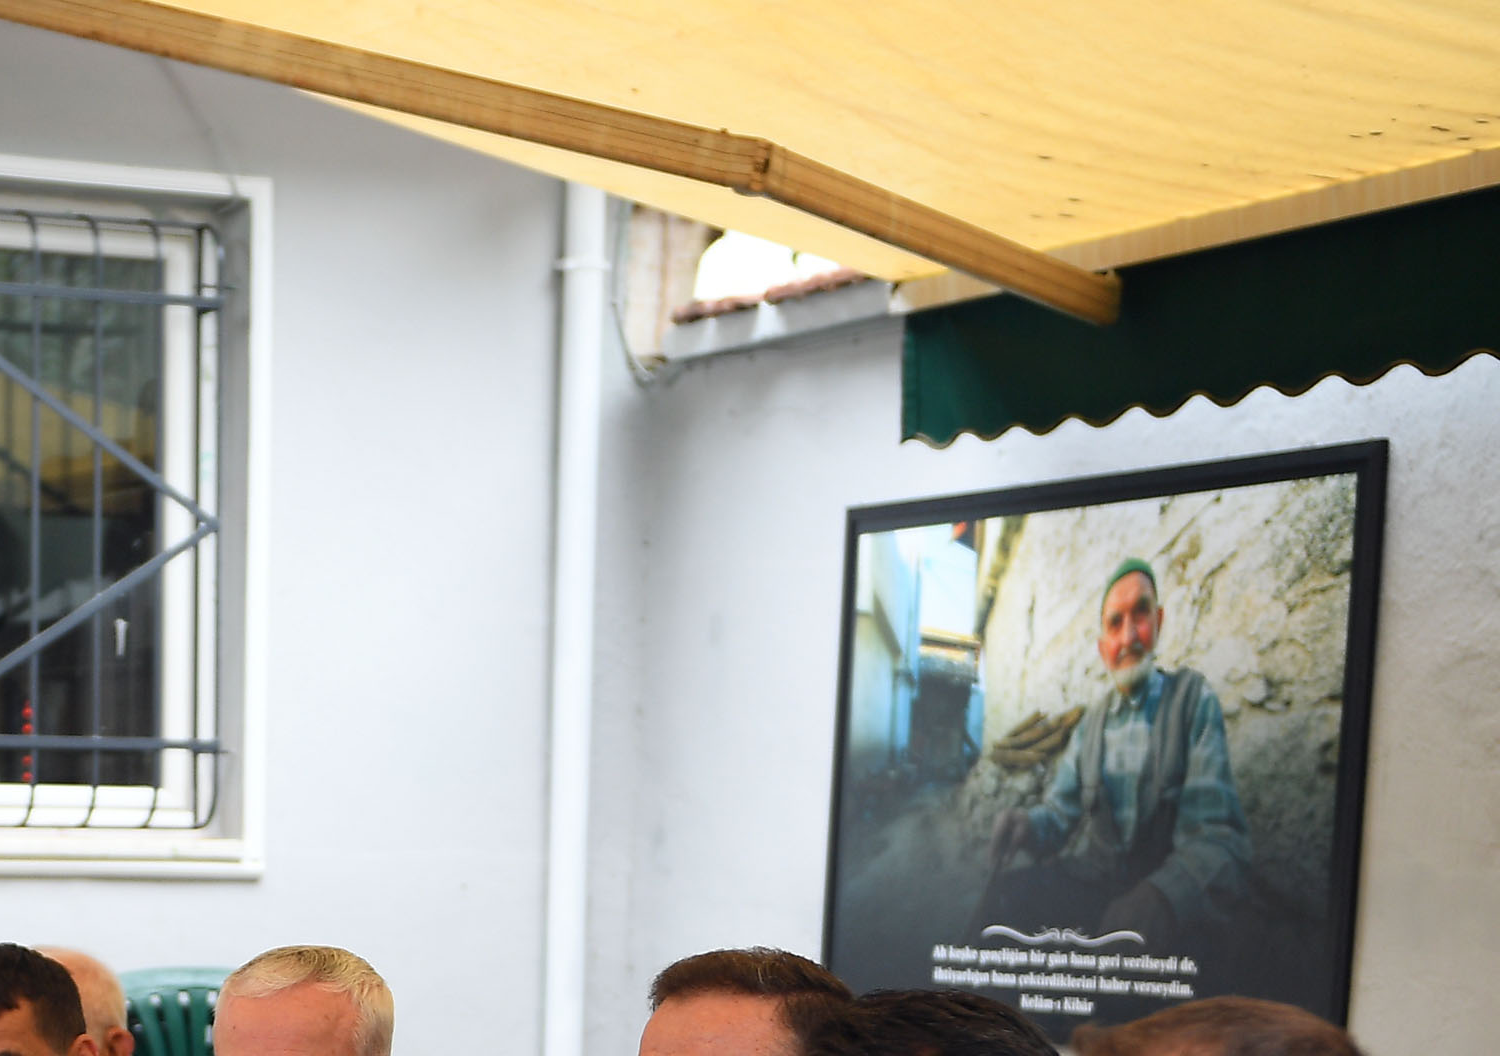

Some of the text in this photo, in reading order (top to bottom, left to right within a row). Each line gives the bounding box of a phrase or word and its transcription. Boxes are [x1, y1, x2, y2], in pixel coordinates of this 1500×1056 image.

[933, 944, 947, 960] Ah
[949, 945, 978, 962] keşke
[1030, 949, 1046, 962] bir
[1047, 950, 1068, 968] gün
[1070, 951, 1096, 965] bana
[1098, 953, 1120, 971] geri
[992, 970, 1016, 984] bana
[1099, 976, 1132, 992] haber
